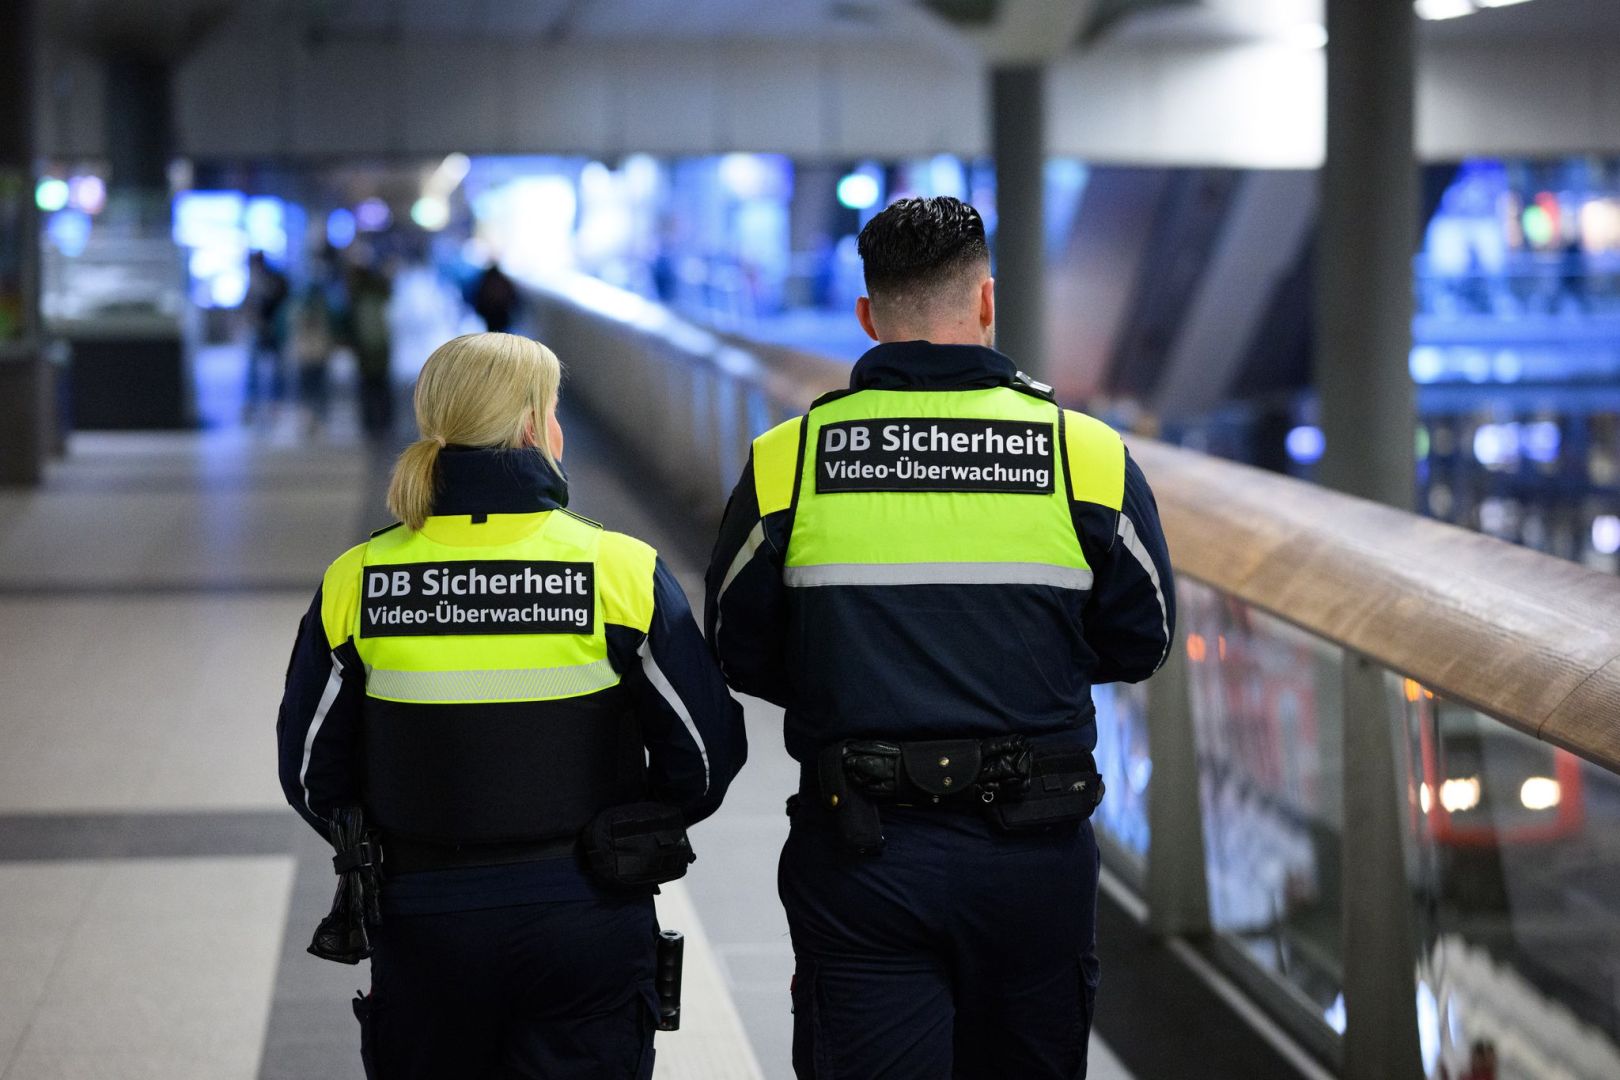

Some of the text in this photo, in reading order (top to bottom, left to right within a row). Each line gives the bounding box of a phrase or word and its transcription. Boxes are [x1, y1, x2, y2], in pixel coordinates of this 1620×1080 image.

[824, 424, 1049, 456] DB Sicherheit
[824, 456, 1049, 488] Video-Überwachung
[367, 567, 588, 598] DB Sicherheit
[367, 600, 588, 627] Video-Überwachung
